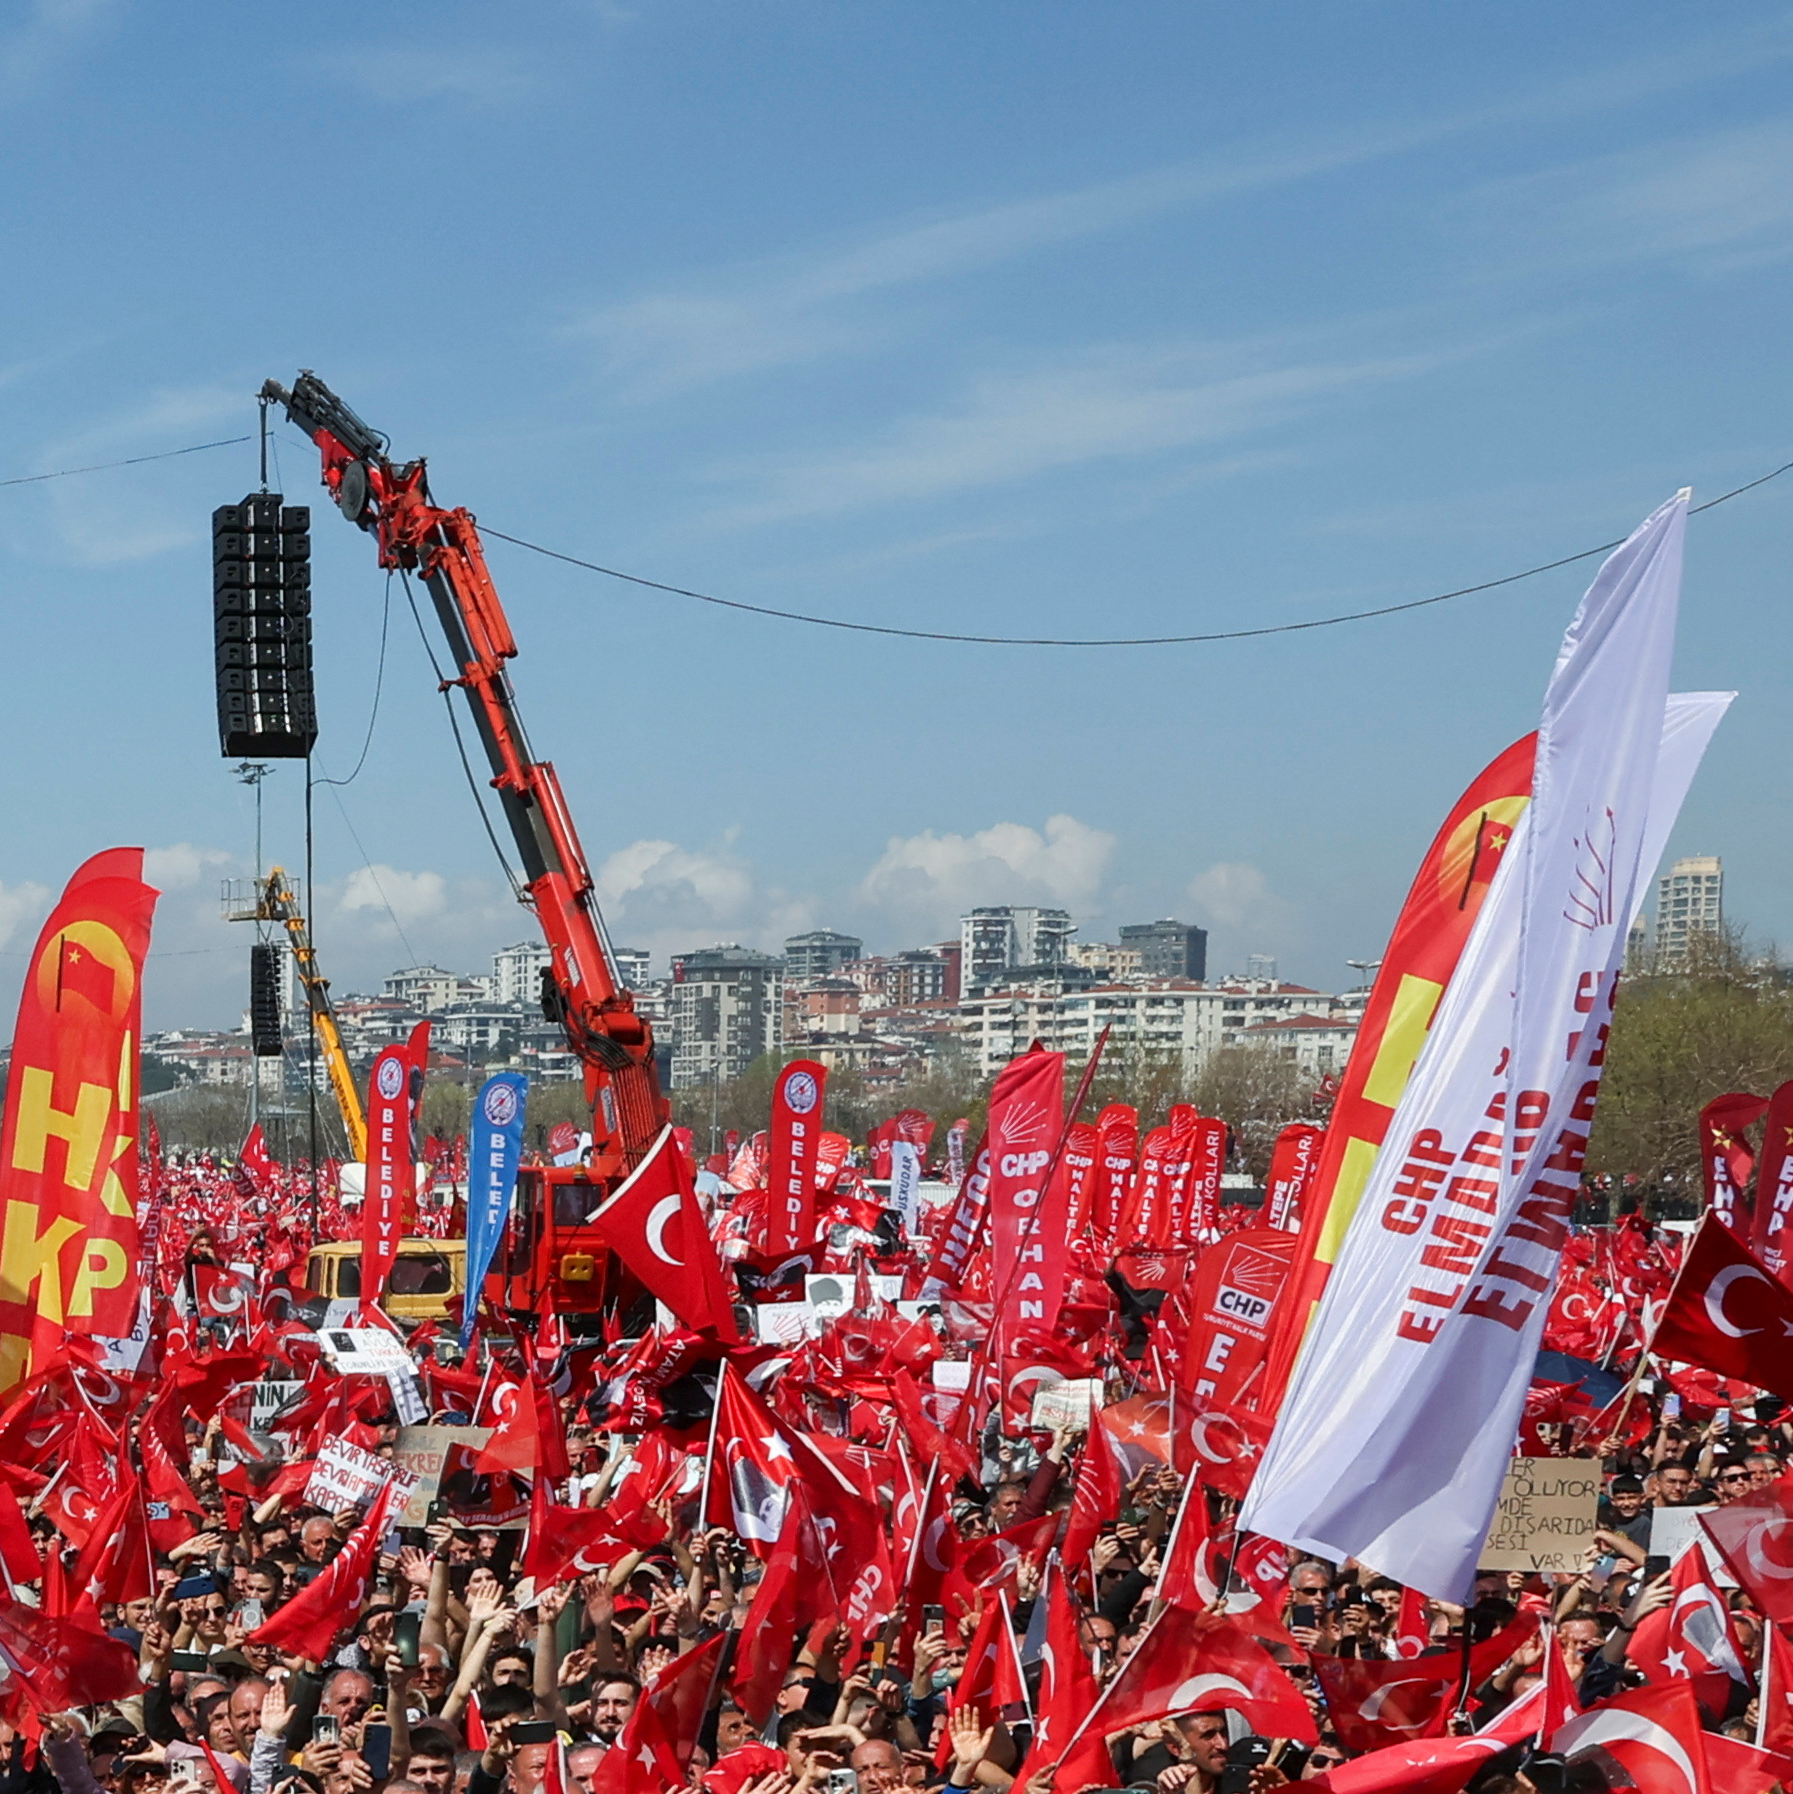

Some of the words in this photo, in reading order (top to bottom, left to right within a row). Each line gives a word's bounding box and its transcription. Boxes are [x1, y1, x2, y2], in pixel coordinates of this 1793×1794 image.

[378, 1108, 395, 1256] BELEDİYE
[785, 1122, 806, 1250] BELEDİY
[1000, 1150, 1050, 1178] CHP
[1065, 1153, 1094, 1168] CHP
[1105, 1155, 1131, 1170] CHP
[1290, 1136, 1313, 1193] OLLARI
[1381, 1128, 1457, 1236] CHP
[1066, 1170, 1083, 1230] MALTE
[1109, 1174, 1124, 1234] MALTE
[1138, 1175, 1158, 1235] MALTE
[1268, 1180, 1288, 1229] LTEPE
[1220, 1291, 1266, 1318] CHP
[1530, 1553, 1565, 1570] VAR
